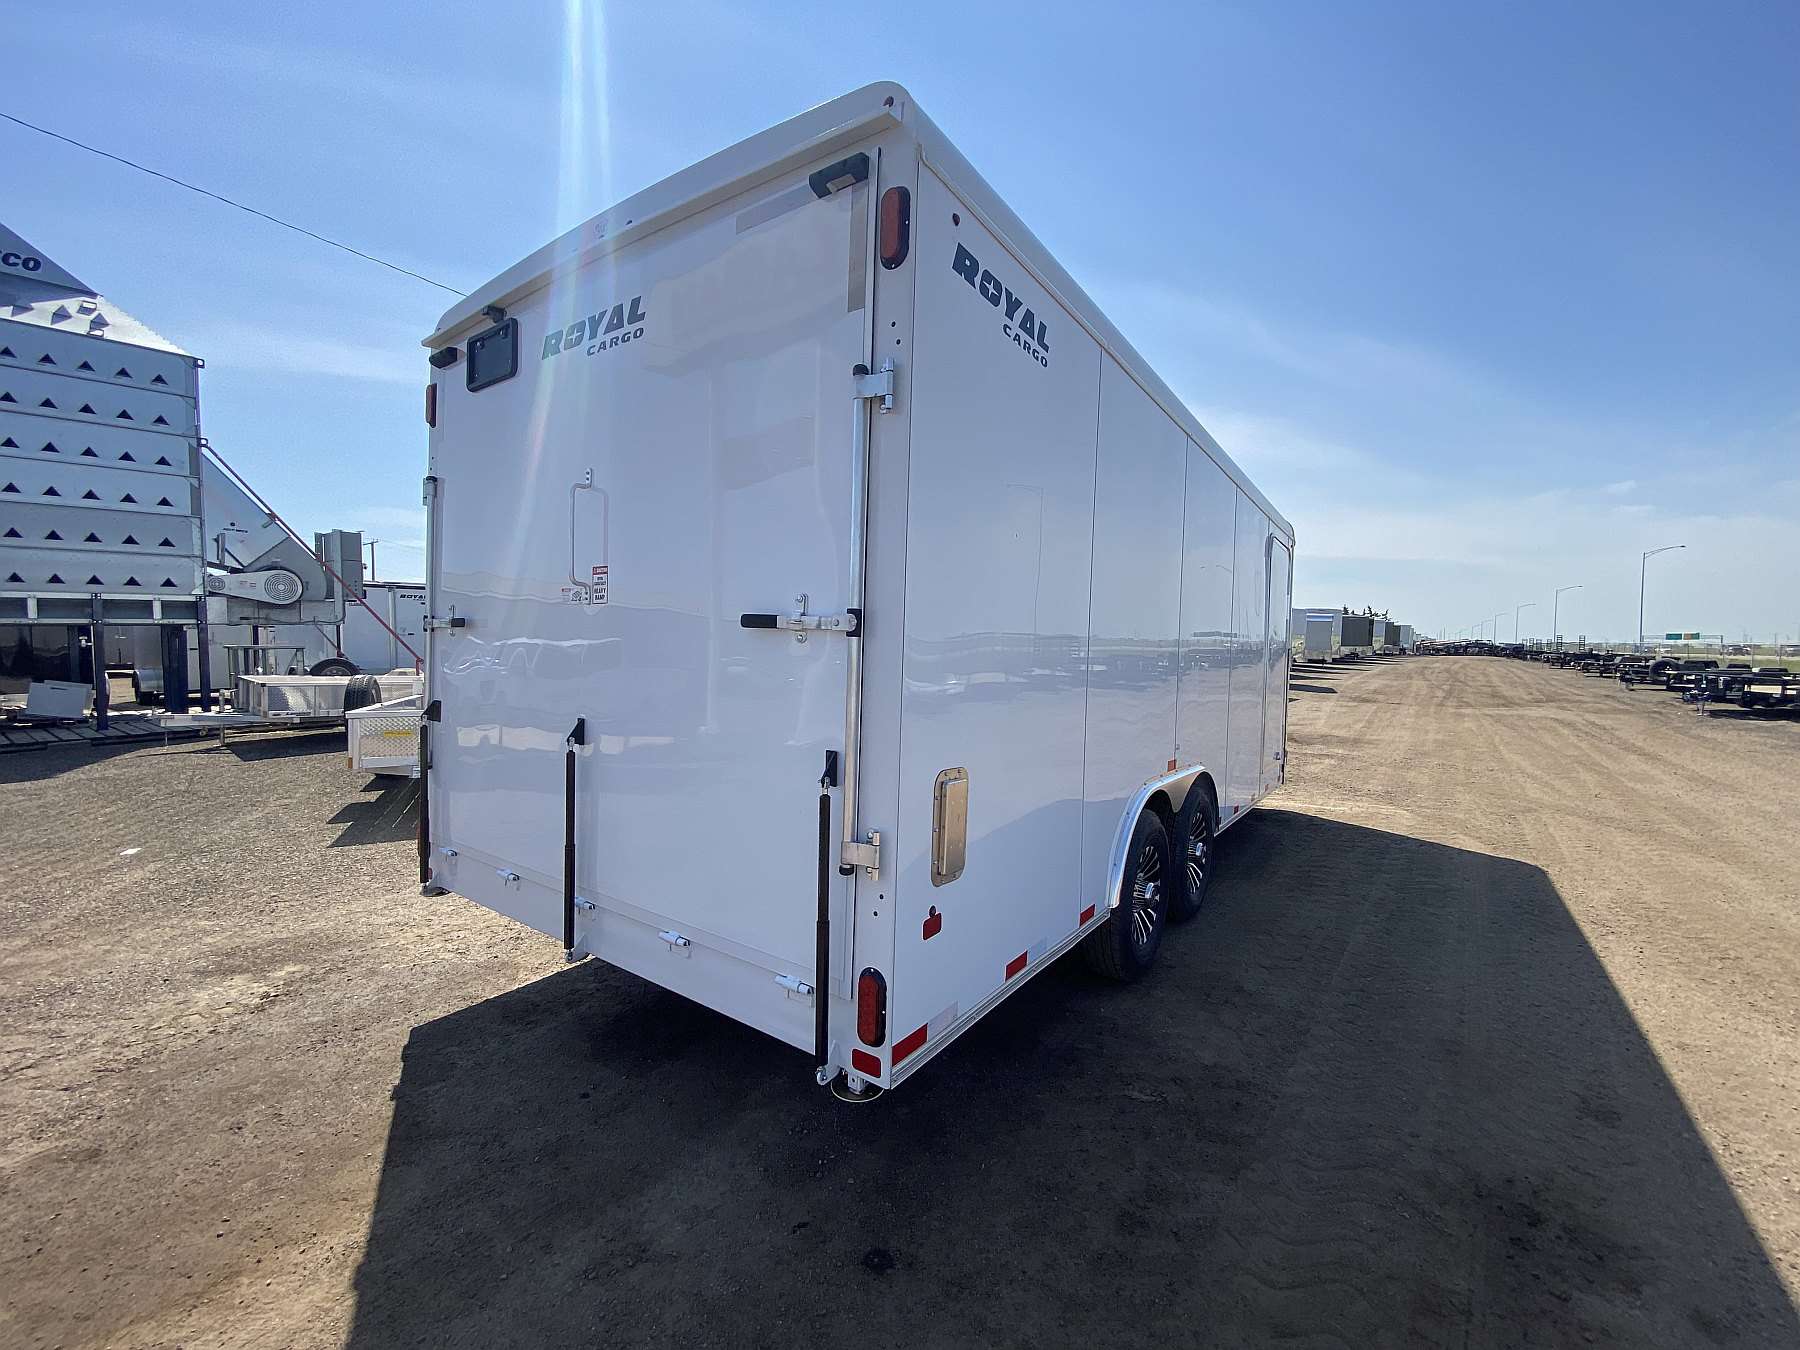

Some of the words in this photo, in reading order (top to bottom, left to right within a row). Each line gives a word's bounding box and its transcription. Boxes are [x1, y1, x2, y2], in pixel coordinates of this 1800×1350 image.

[0, 250, 42, 271] CO
[952, 242, 1050, 353] ROYAL
[542, 296, 646, 360] ROYAL
[587, 327, 644, 357] CARGO
[1002, 323, 1048, 368] CARGO
